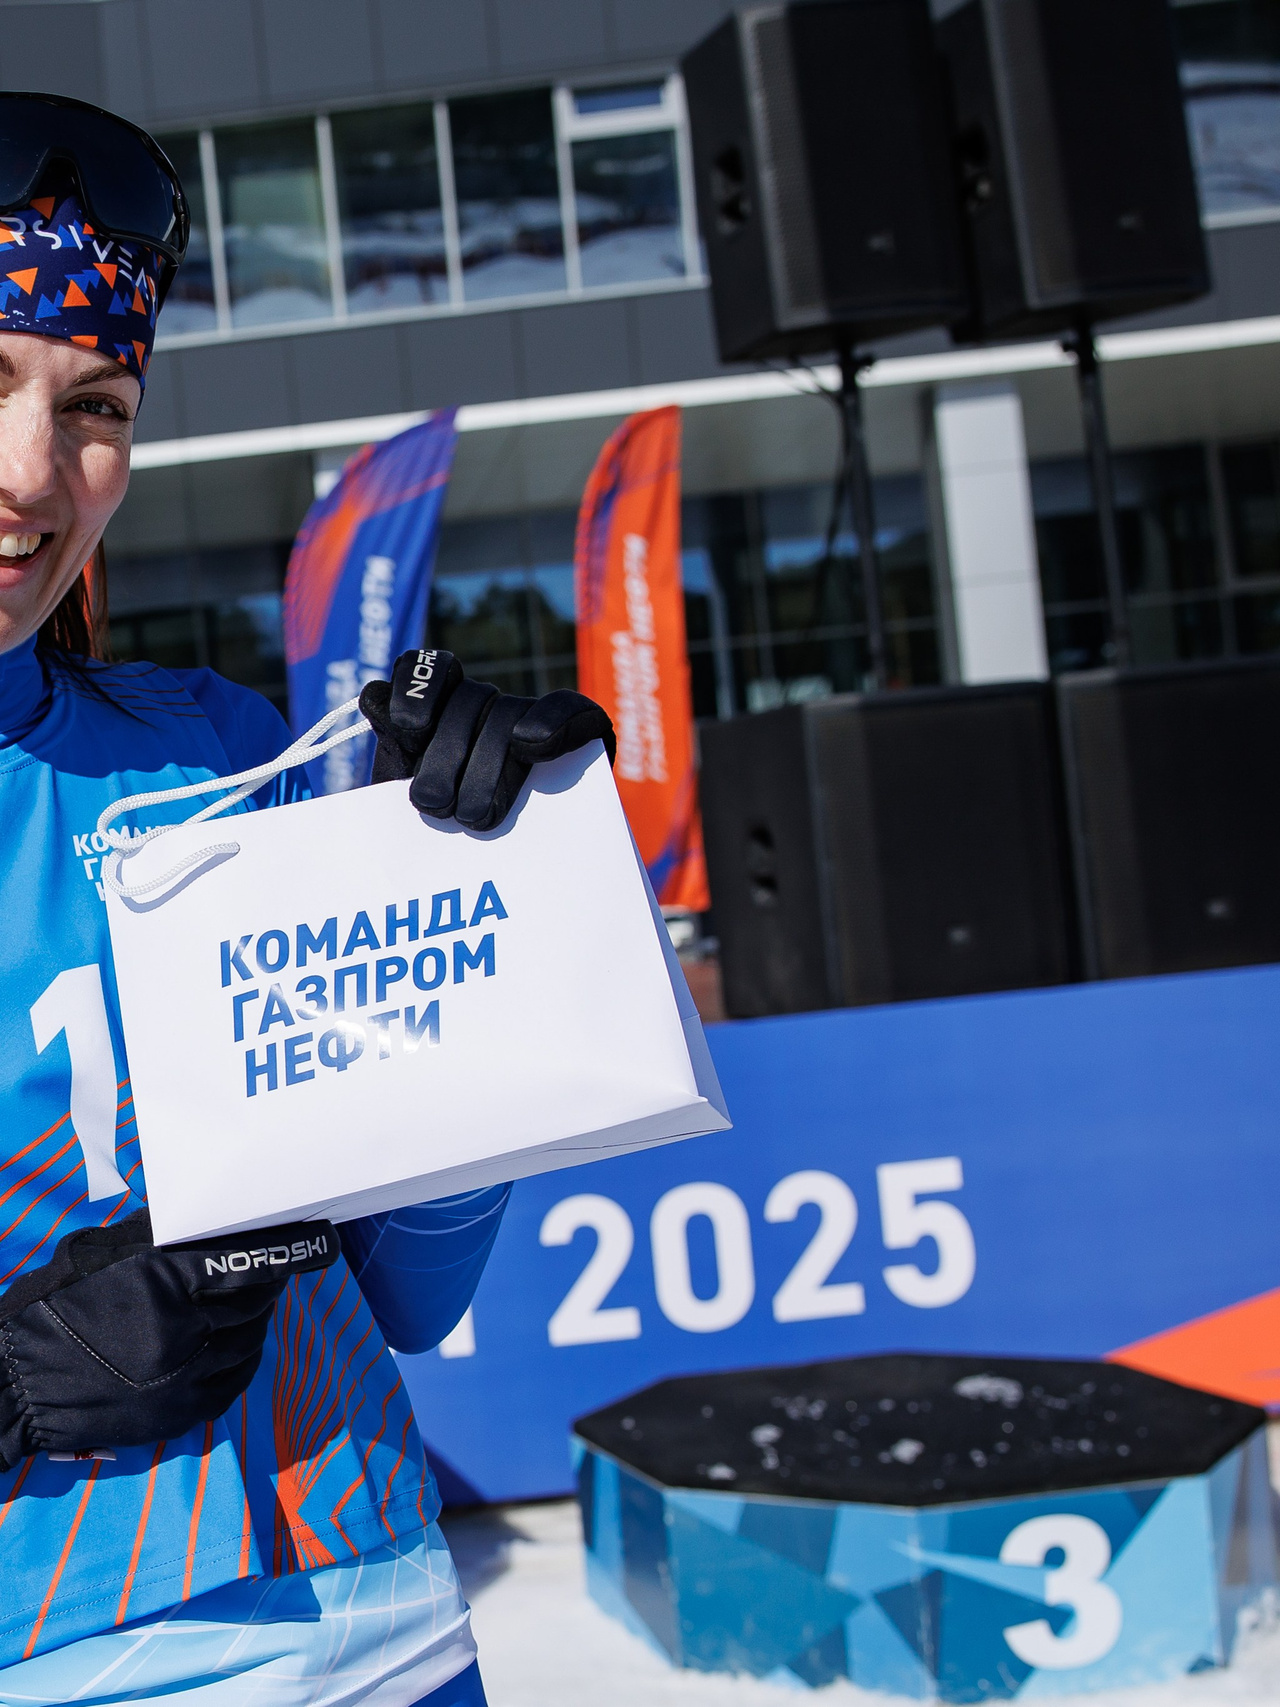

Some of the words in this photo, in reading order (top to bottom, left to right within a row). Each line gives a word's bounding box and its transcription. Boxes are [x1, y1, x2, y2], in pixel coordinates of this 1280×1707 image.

[220, 880, 509, 988] КОМАНДА
[232, 932, 496, 1043] ГАЗПРОМ
[29, 963, 131, 1203] 1
[245, 999, 441, 1098] НЕФТИ
[204, 1235, 328, 1276] NORDSKI
[538, 1156, 977, 1348] 2025
[998, 1513, 1123, 1671] 3
